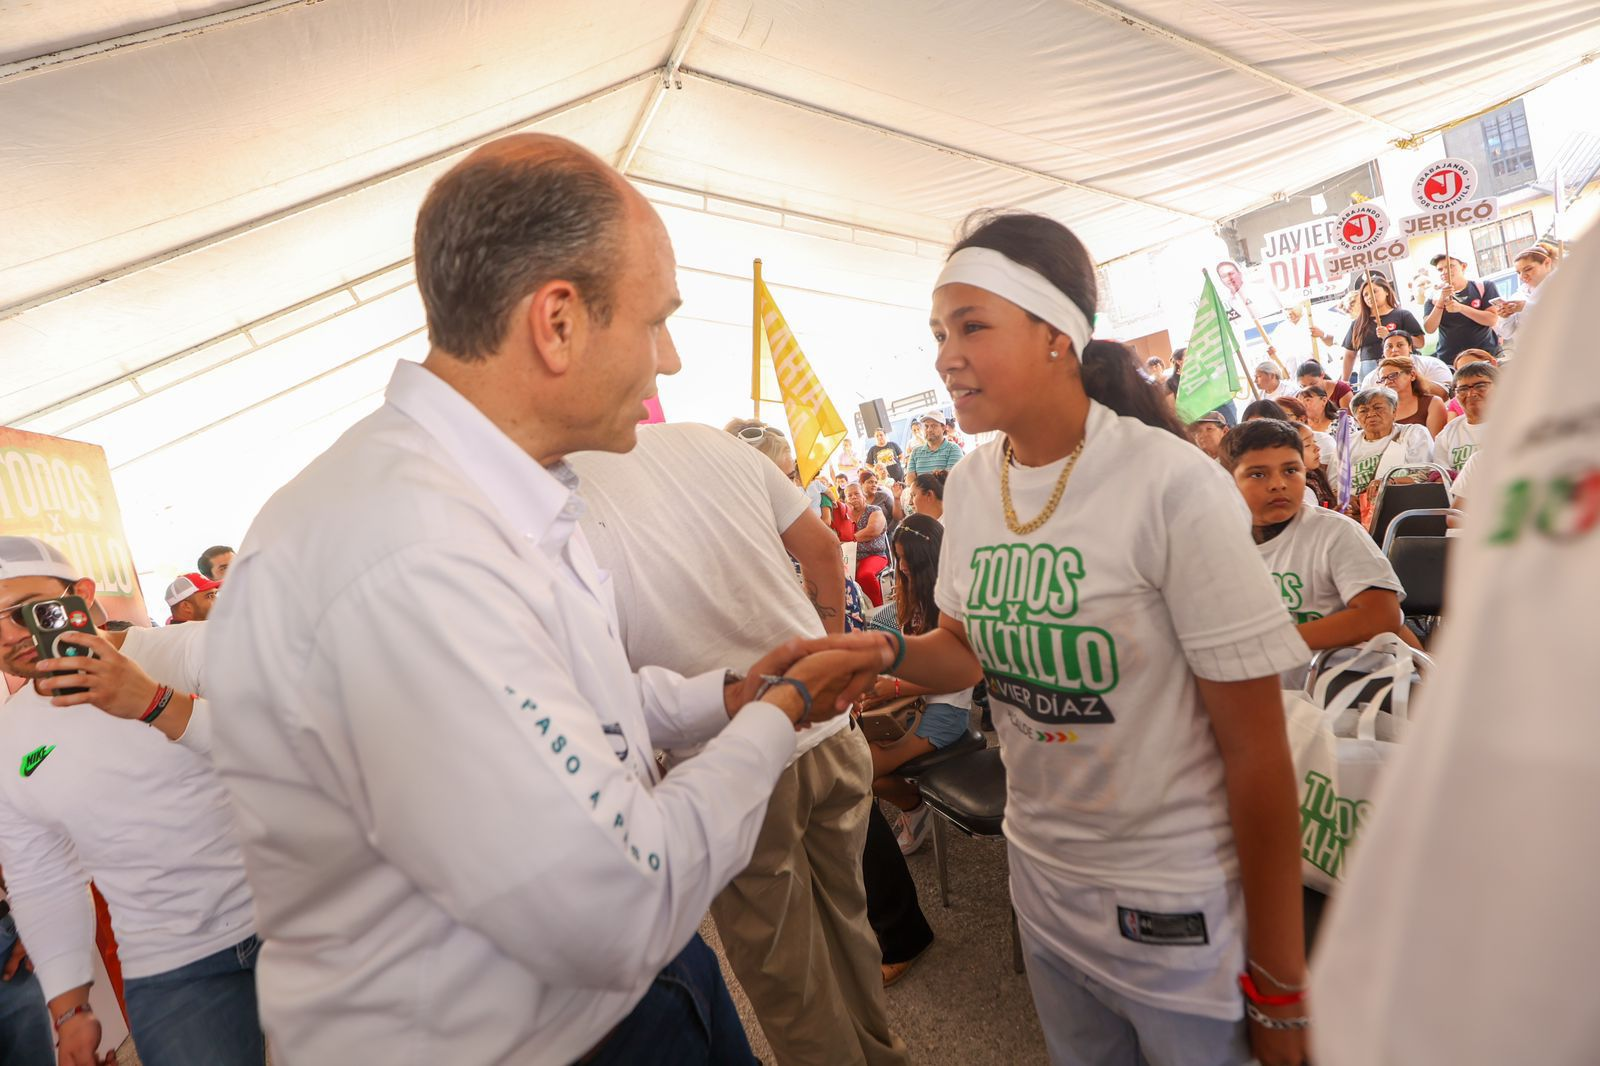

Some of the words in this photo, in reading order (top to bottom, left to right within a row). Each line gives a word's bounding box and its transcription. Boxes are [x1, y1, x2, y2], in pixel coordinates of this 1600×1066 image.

[1416, 162, 1468, 187] TRABAJANDO
[1417, 195, 1431, 208] POR
[1432, 184, 1471, 210] COAHUILA
[1336, 207, 1380, 230] TRABAJANDO
[1404, 199, 1493, 234] JERICÓ
[1338, 237, 1350, 249] POR
[1351, 226, 1384, 251] COAHUILA
[1329, 239, 1405, 273] JERICÓ
[969, 545, 1083, 618] TODOS
[968, 618, 1117, 692] ALTILLO
[1036, 693, 1103, 717] DÍAZ
[26, 745, 47, 768] NIKE
